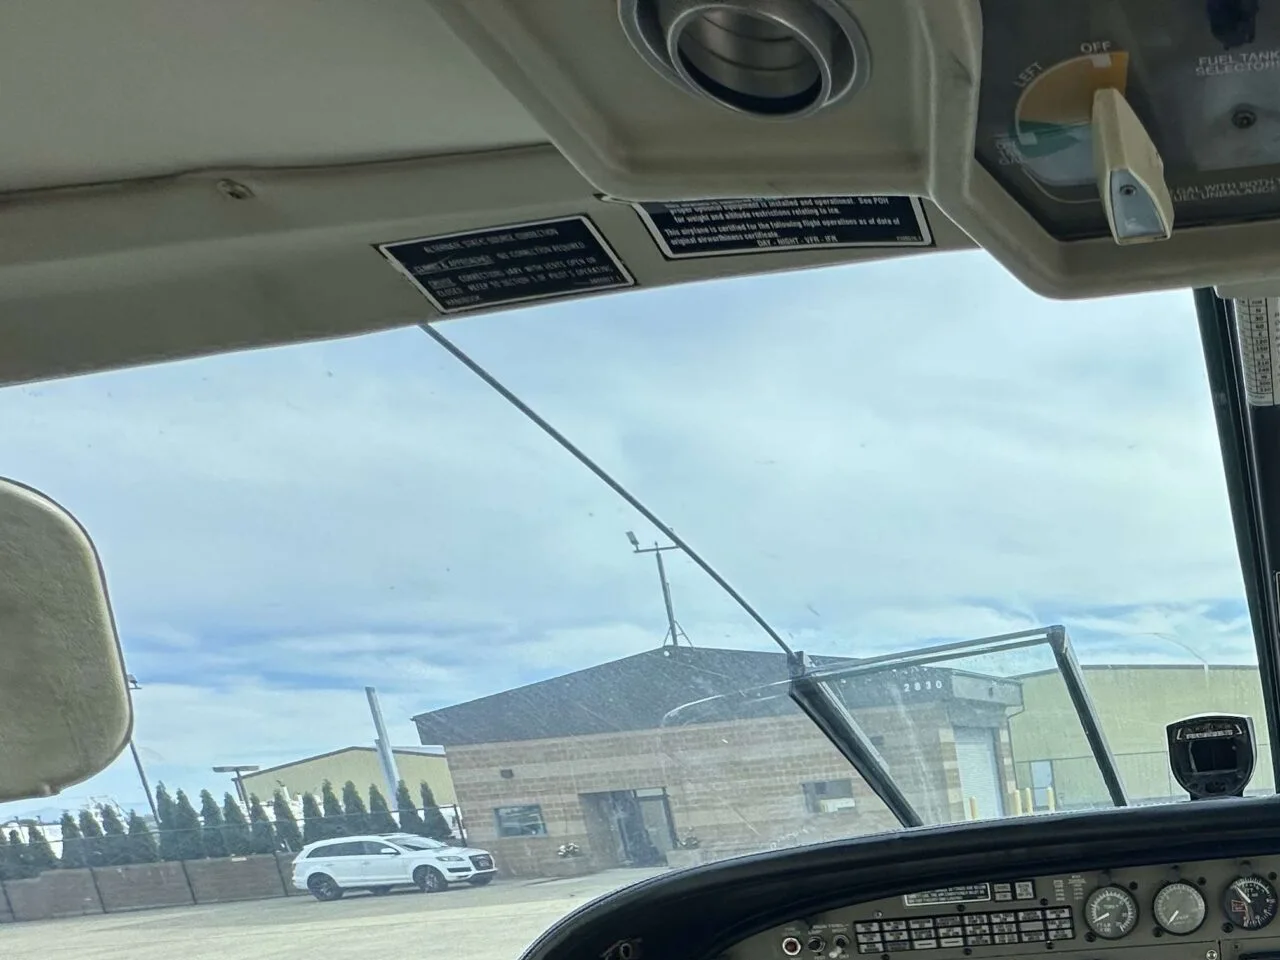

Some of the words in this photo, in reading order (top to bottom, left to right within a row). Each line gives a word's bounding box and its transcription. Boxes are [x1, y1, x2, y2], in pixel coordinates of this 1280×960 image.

[1081, 41, 1111, 53] OFF
[1198, 54, 1236, 67] FUEL
[1239, 50, 1280, 64] TANK
[1013, 61, 1044, 88] LEFT
